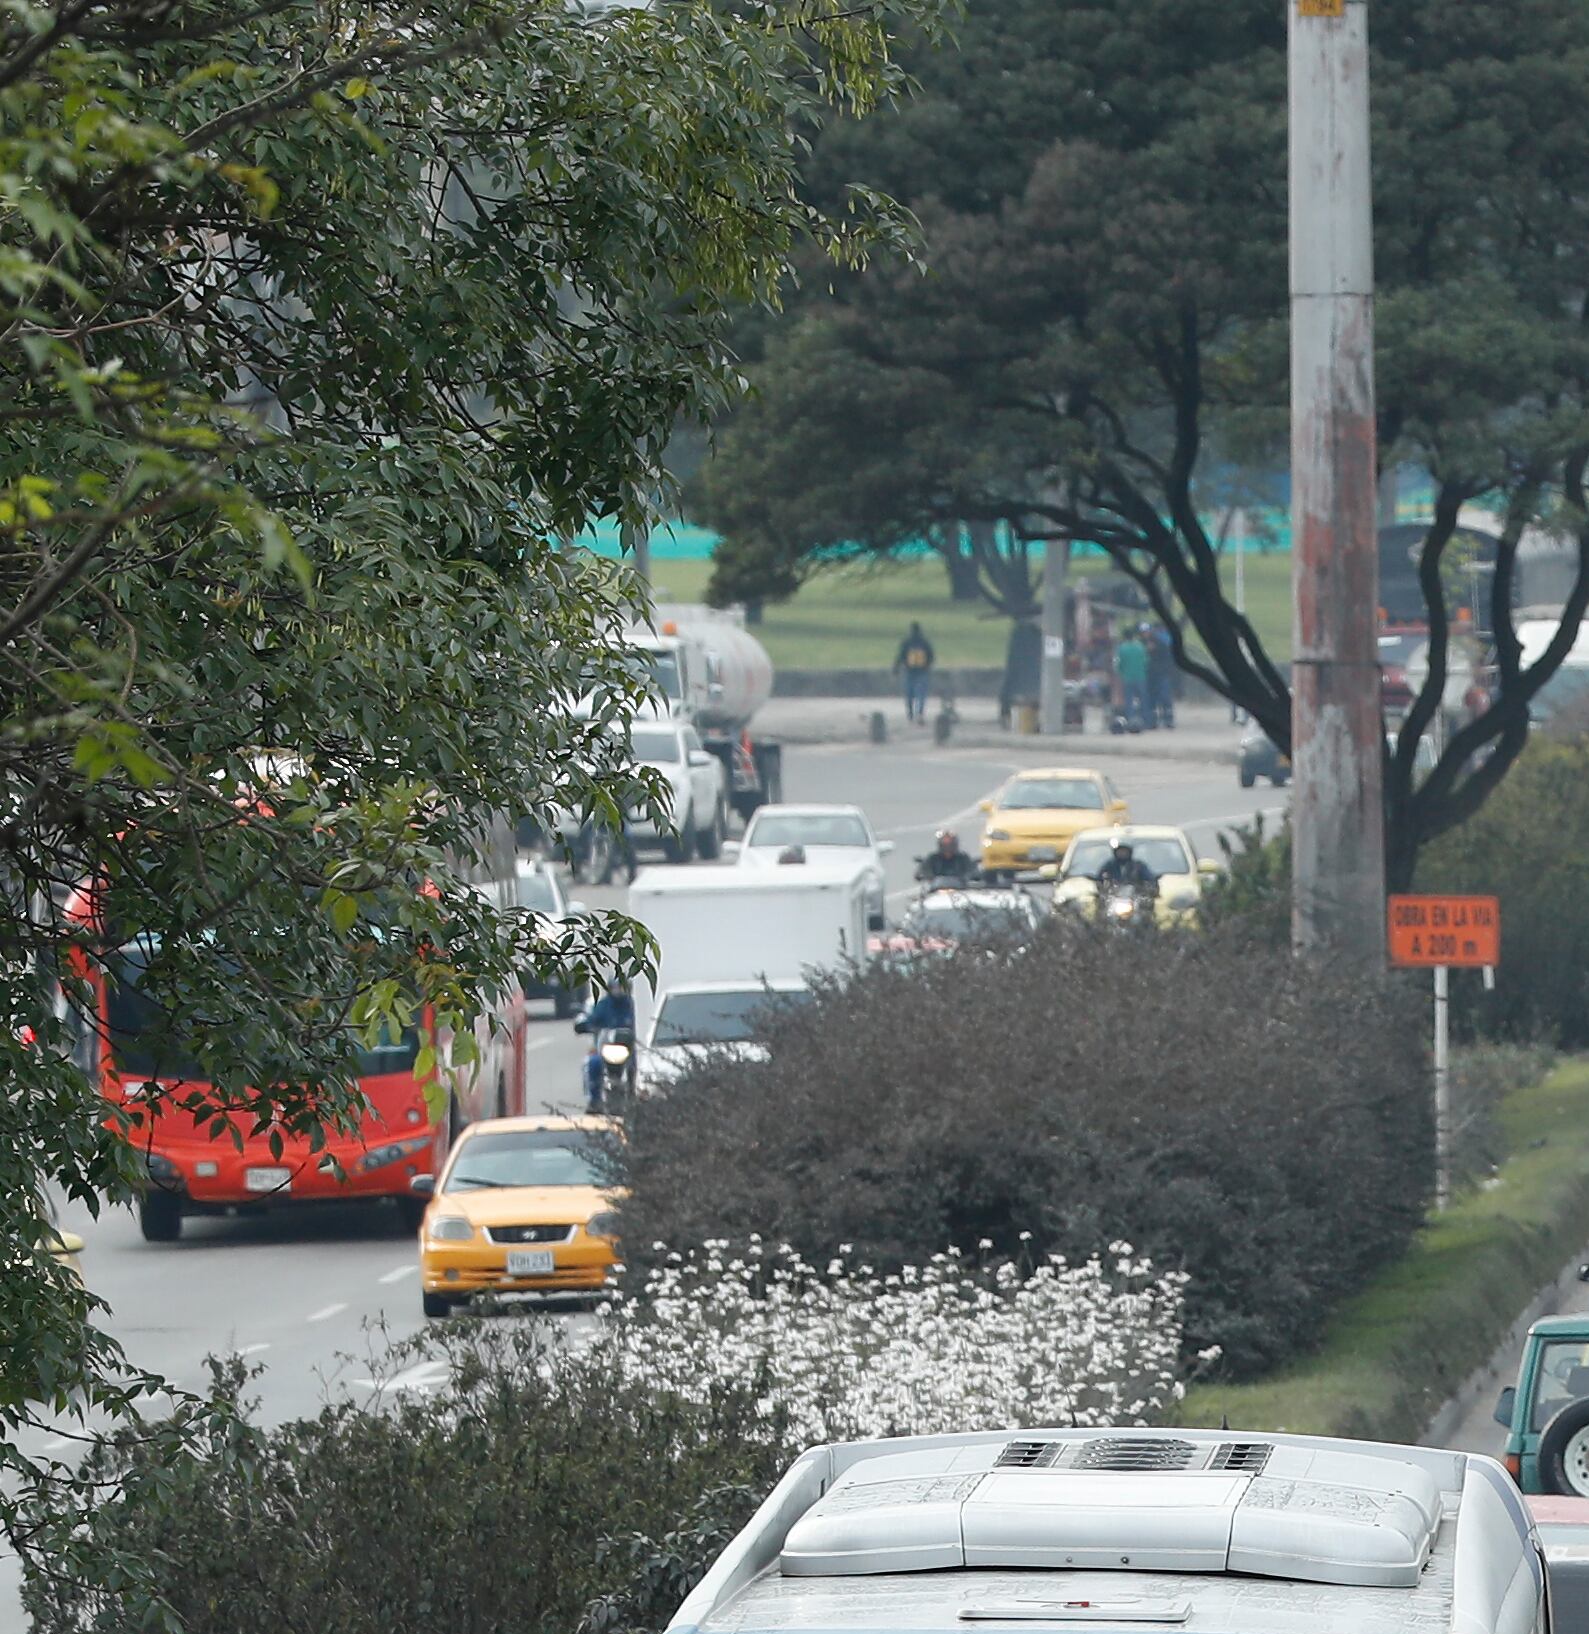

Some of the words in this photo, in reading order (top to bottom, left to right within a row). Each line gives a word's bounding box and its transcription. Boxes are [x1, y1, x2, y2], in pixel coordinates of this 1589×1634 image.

[1395, 904, 1427, 927] OBRA
[1431, 904, 1449, 926] EN
[1453, 904, 1469, 927] LA
[1472, 905, 1493, 927] VIA
[1411, 934, 1422, 955] A
[1428, 935, 1457, 956] 200
